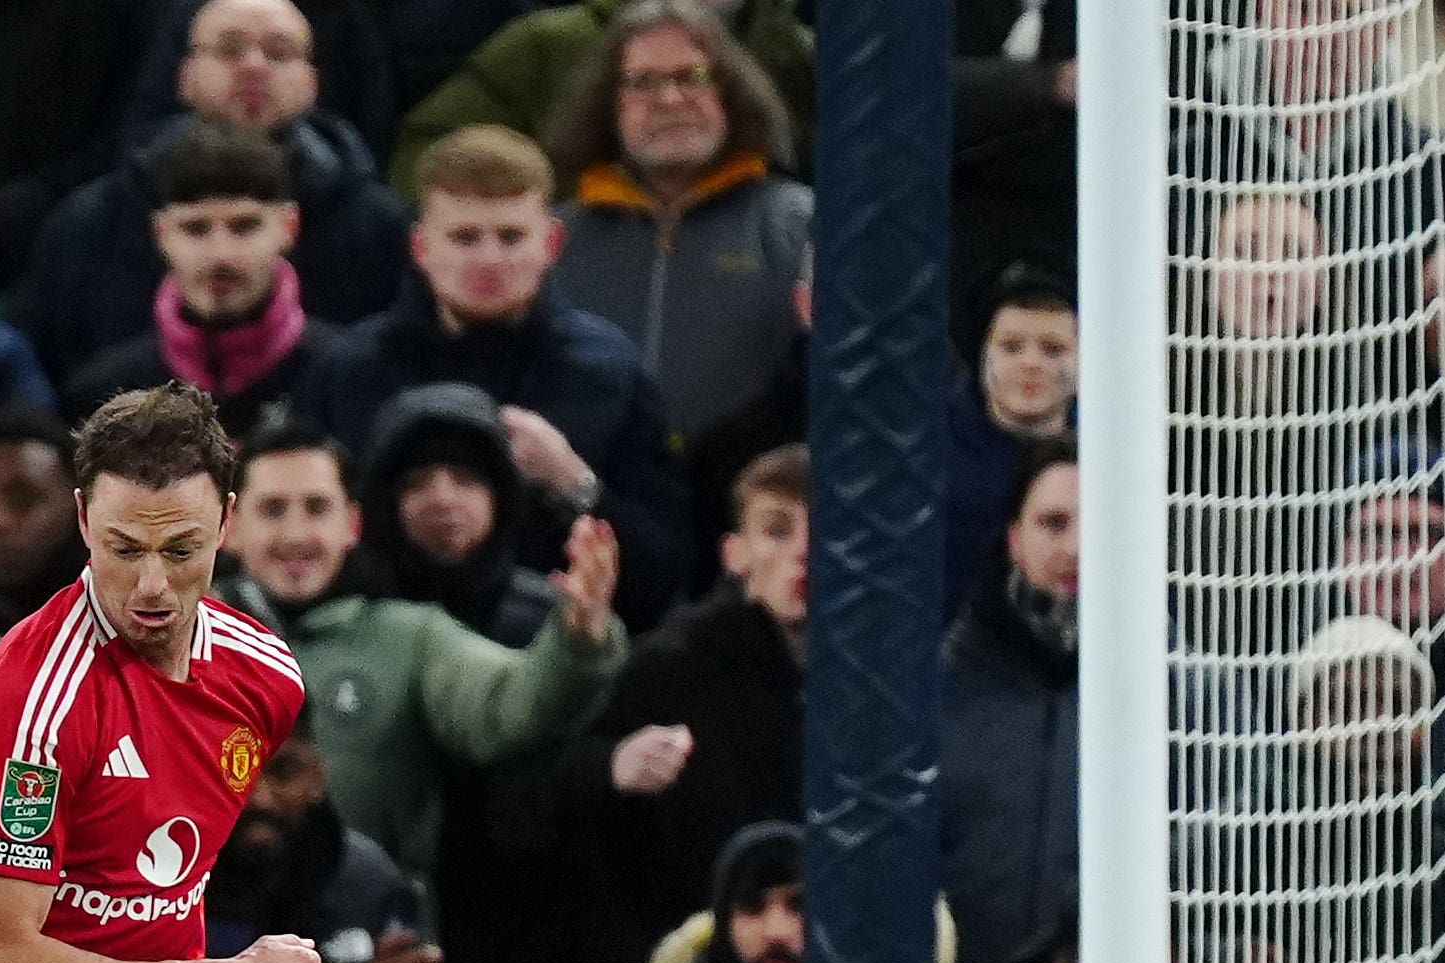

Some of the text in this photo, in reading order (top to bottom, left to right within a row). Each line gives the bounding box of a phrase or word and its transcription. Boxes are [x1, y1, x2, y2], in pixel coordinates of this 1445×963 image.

[4, 795, 52, 807] Carabao
[15, 806, 38, 818] Cup
[22, 825, 36, 835] EFL
[9, 843, 48, 858] room
